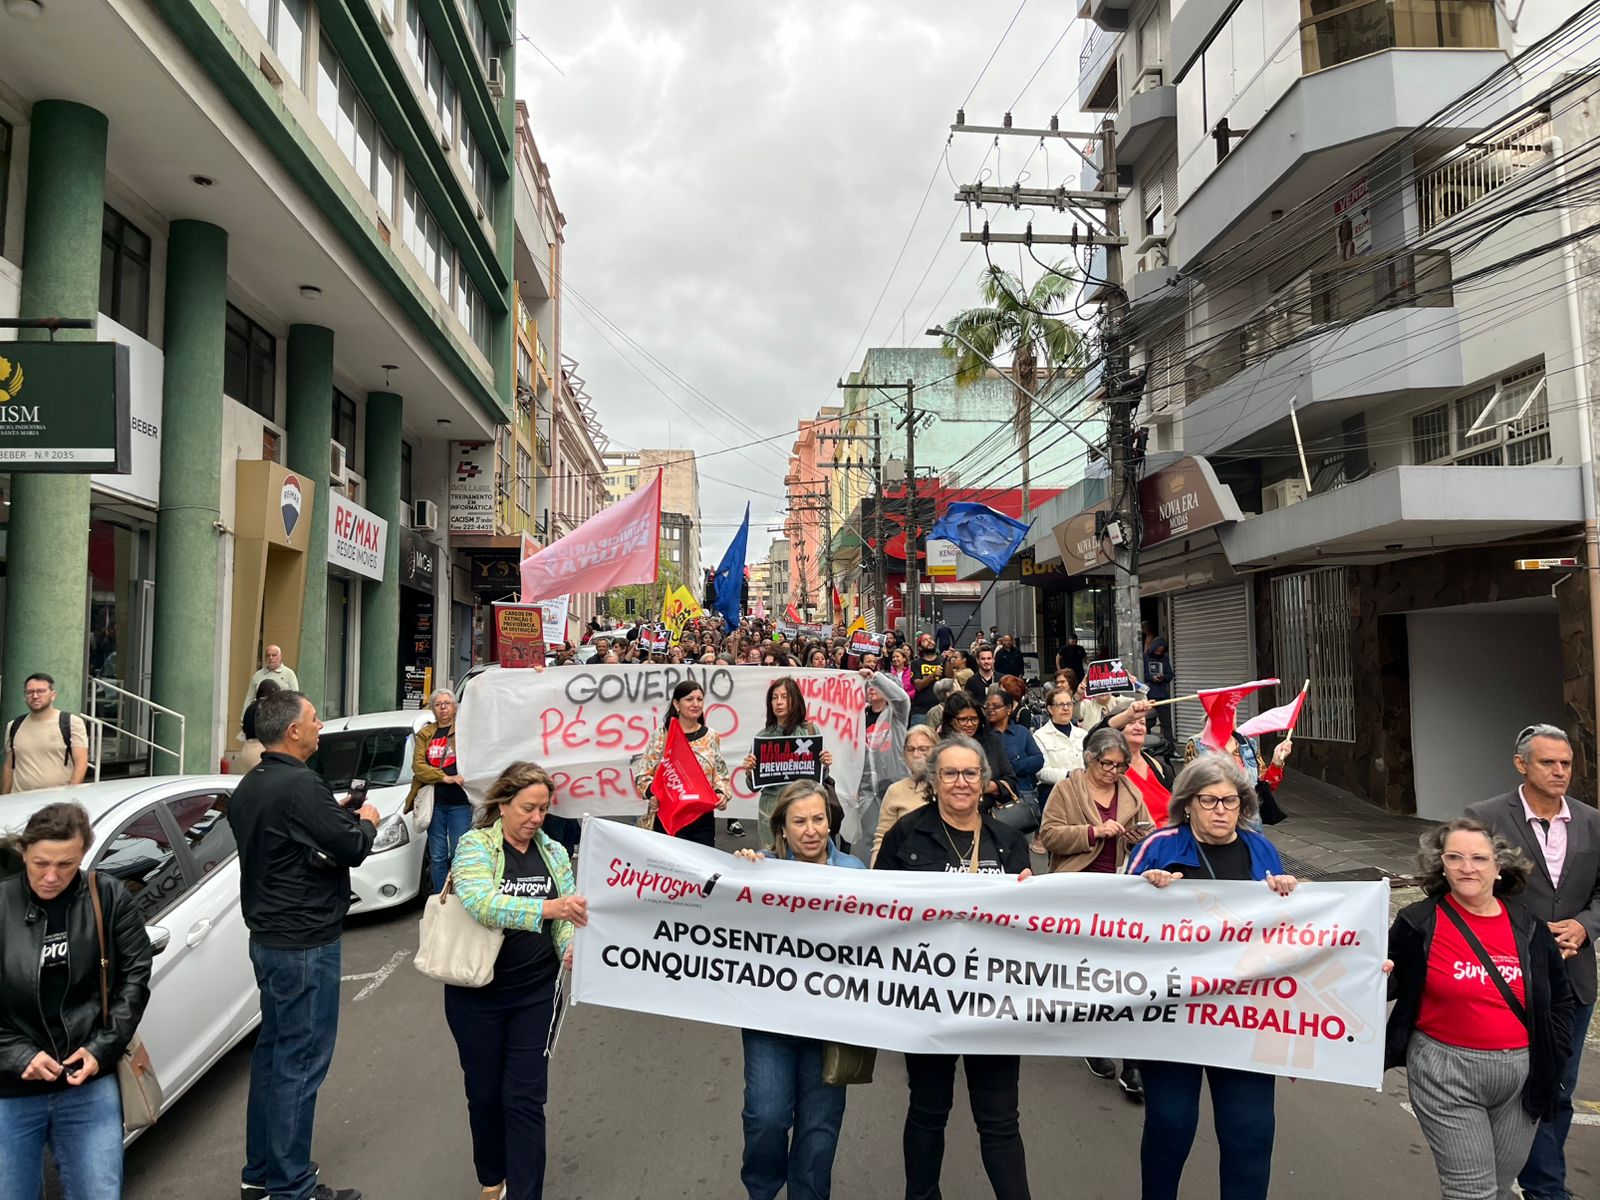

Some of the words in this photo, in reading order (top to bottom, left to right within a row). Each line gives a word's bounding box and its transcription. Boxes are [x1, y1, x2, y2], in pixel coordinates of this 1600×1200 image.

[132, 416, 158, 439] BEBER
[52, 451, 74, 459] 2035
[334, 505, 380, 552] RE/MAX
[1159, 499, 1181, 521] NOVA
[1181, 491, 1200, 512] ERA
[540, 703, 740, 756] PÉSSIO
[761, 740, 780, 753] NÃO
[806, 702, 860, 750] LUTA!
[760, 759, 815, 773] PREVIDÊNCIA!
[736, 886, 753, 904] A
[761, 890, 914, 923] experiência
[921, 905, 1020, 928] ensina:
[1026, 915, 1082, 936] sem
[1090, 913, 1150, 944] luta,
[1160, 918, 1211, 943] não
[1219, 916, 1253, 943] há
[1261, 919, 1362, 948] vitória.
[653, 920, 884, 969] APOSENTADORIA
[892, 942, 956, 977] NÃO
[963, 948, 978, 980] É
[987, 956, 1157, 1001] PRIVILÉGIO,
[1166, 967, 1181, 998] É
[1190, 975, 1297, 999] DIREITO
[601, 944, 798, 992] CONQUISTADO
[804, 970, 869, 1003] COM
[876, 982, 941, 1013] UMA
[947, 989, 1018, 1018] VIDA
[1027, 998, 1135, 1023] INTEIRA
[1141, 1003, 1177, 1023] DE
[1184, 1002, 1355, 1044] TRABALHO.
